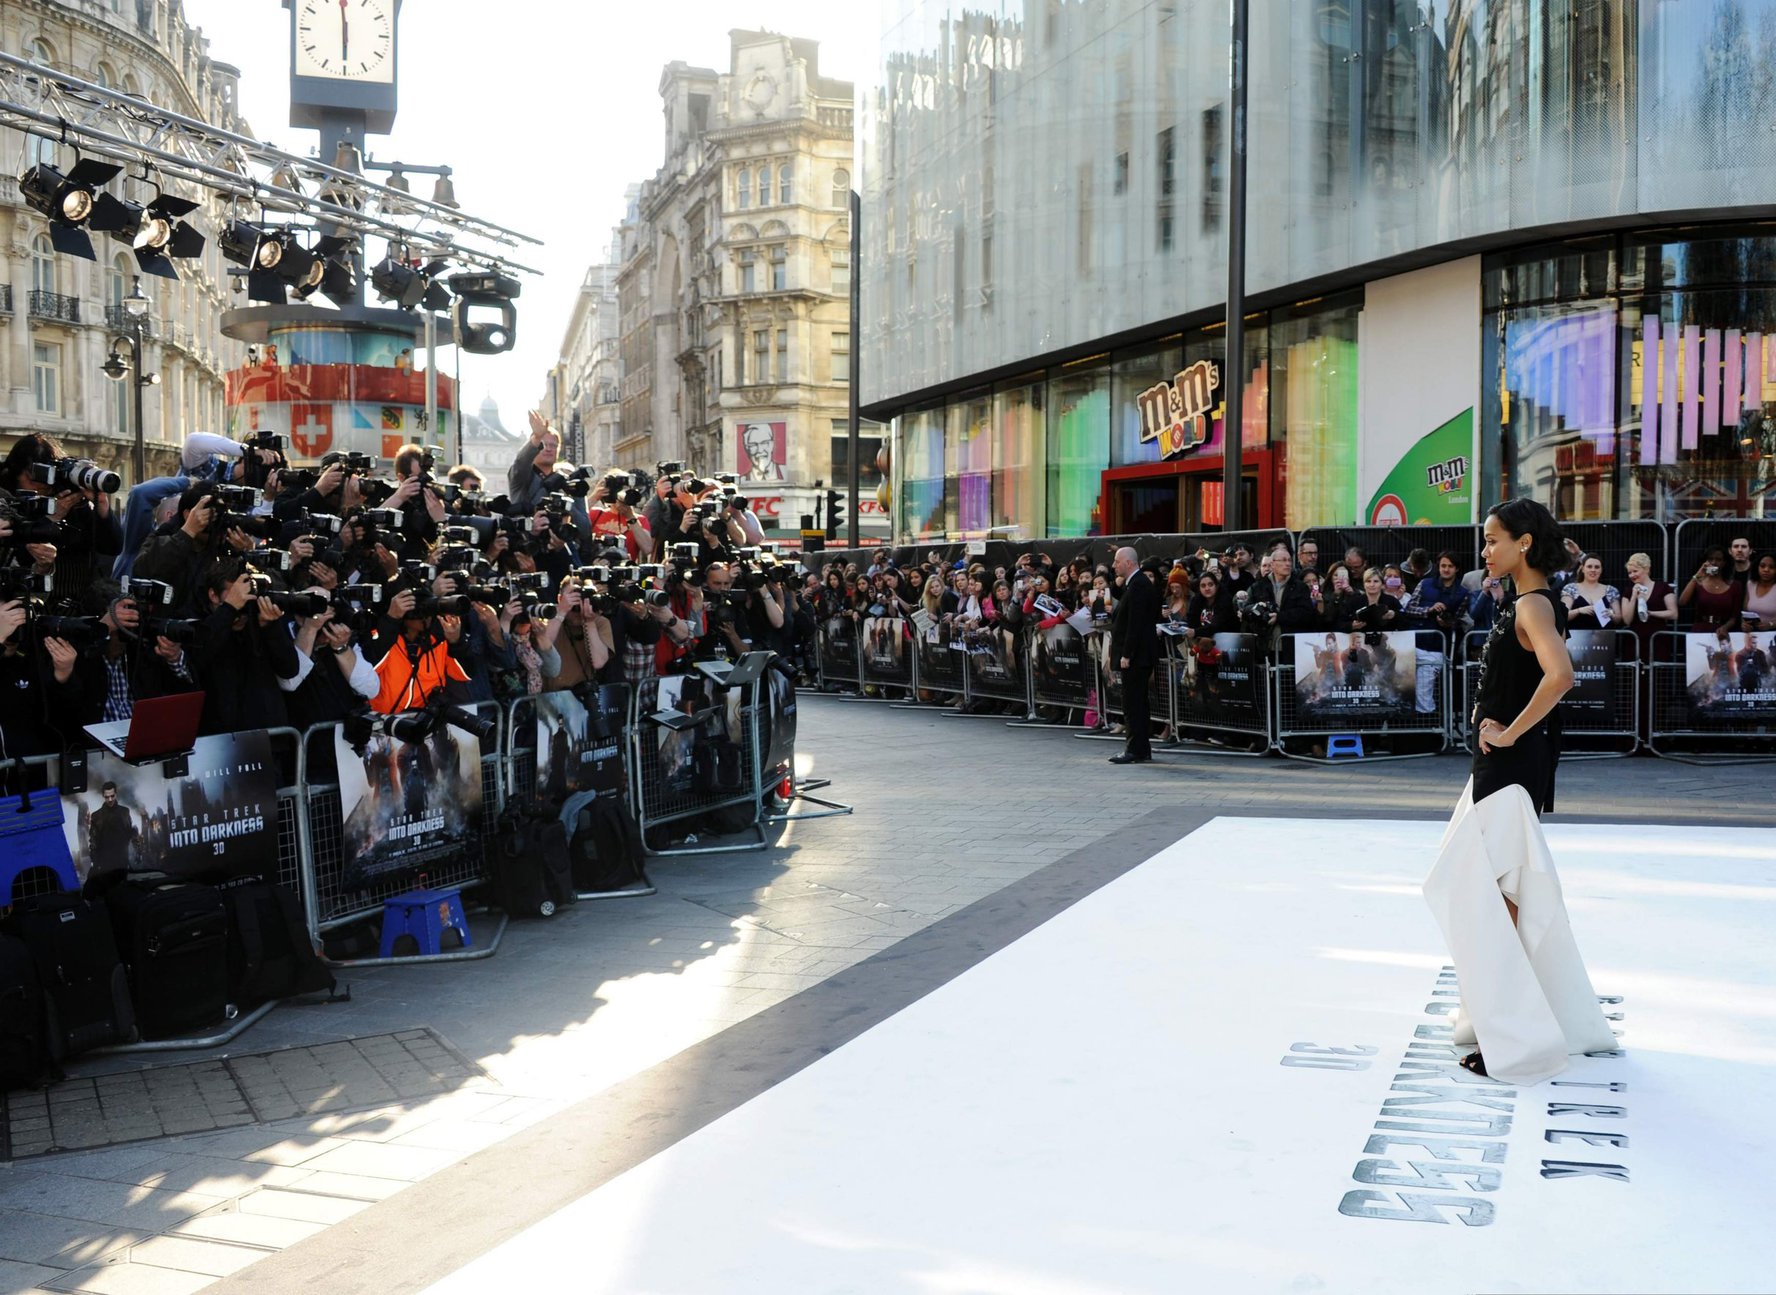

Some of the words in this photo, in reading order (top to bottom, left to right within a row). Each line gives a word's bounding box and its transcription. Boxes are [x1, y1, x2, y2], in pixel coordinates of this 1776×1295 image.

[171, 813, 209, 830] STAR
[223, 803, 260, 820] TREK
[407, 815, 444, 837] DARKNESS
[169, 828, 199, 848] INTO
[202, 815, 264, 843] DARKNESS
[213, 841, 225, 856] 3D
[1540, 1082, 1631, 1184] TREK
